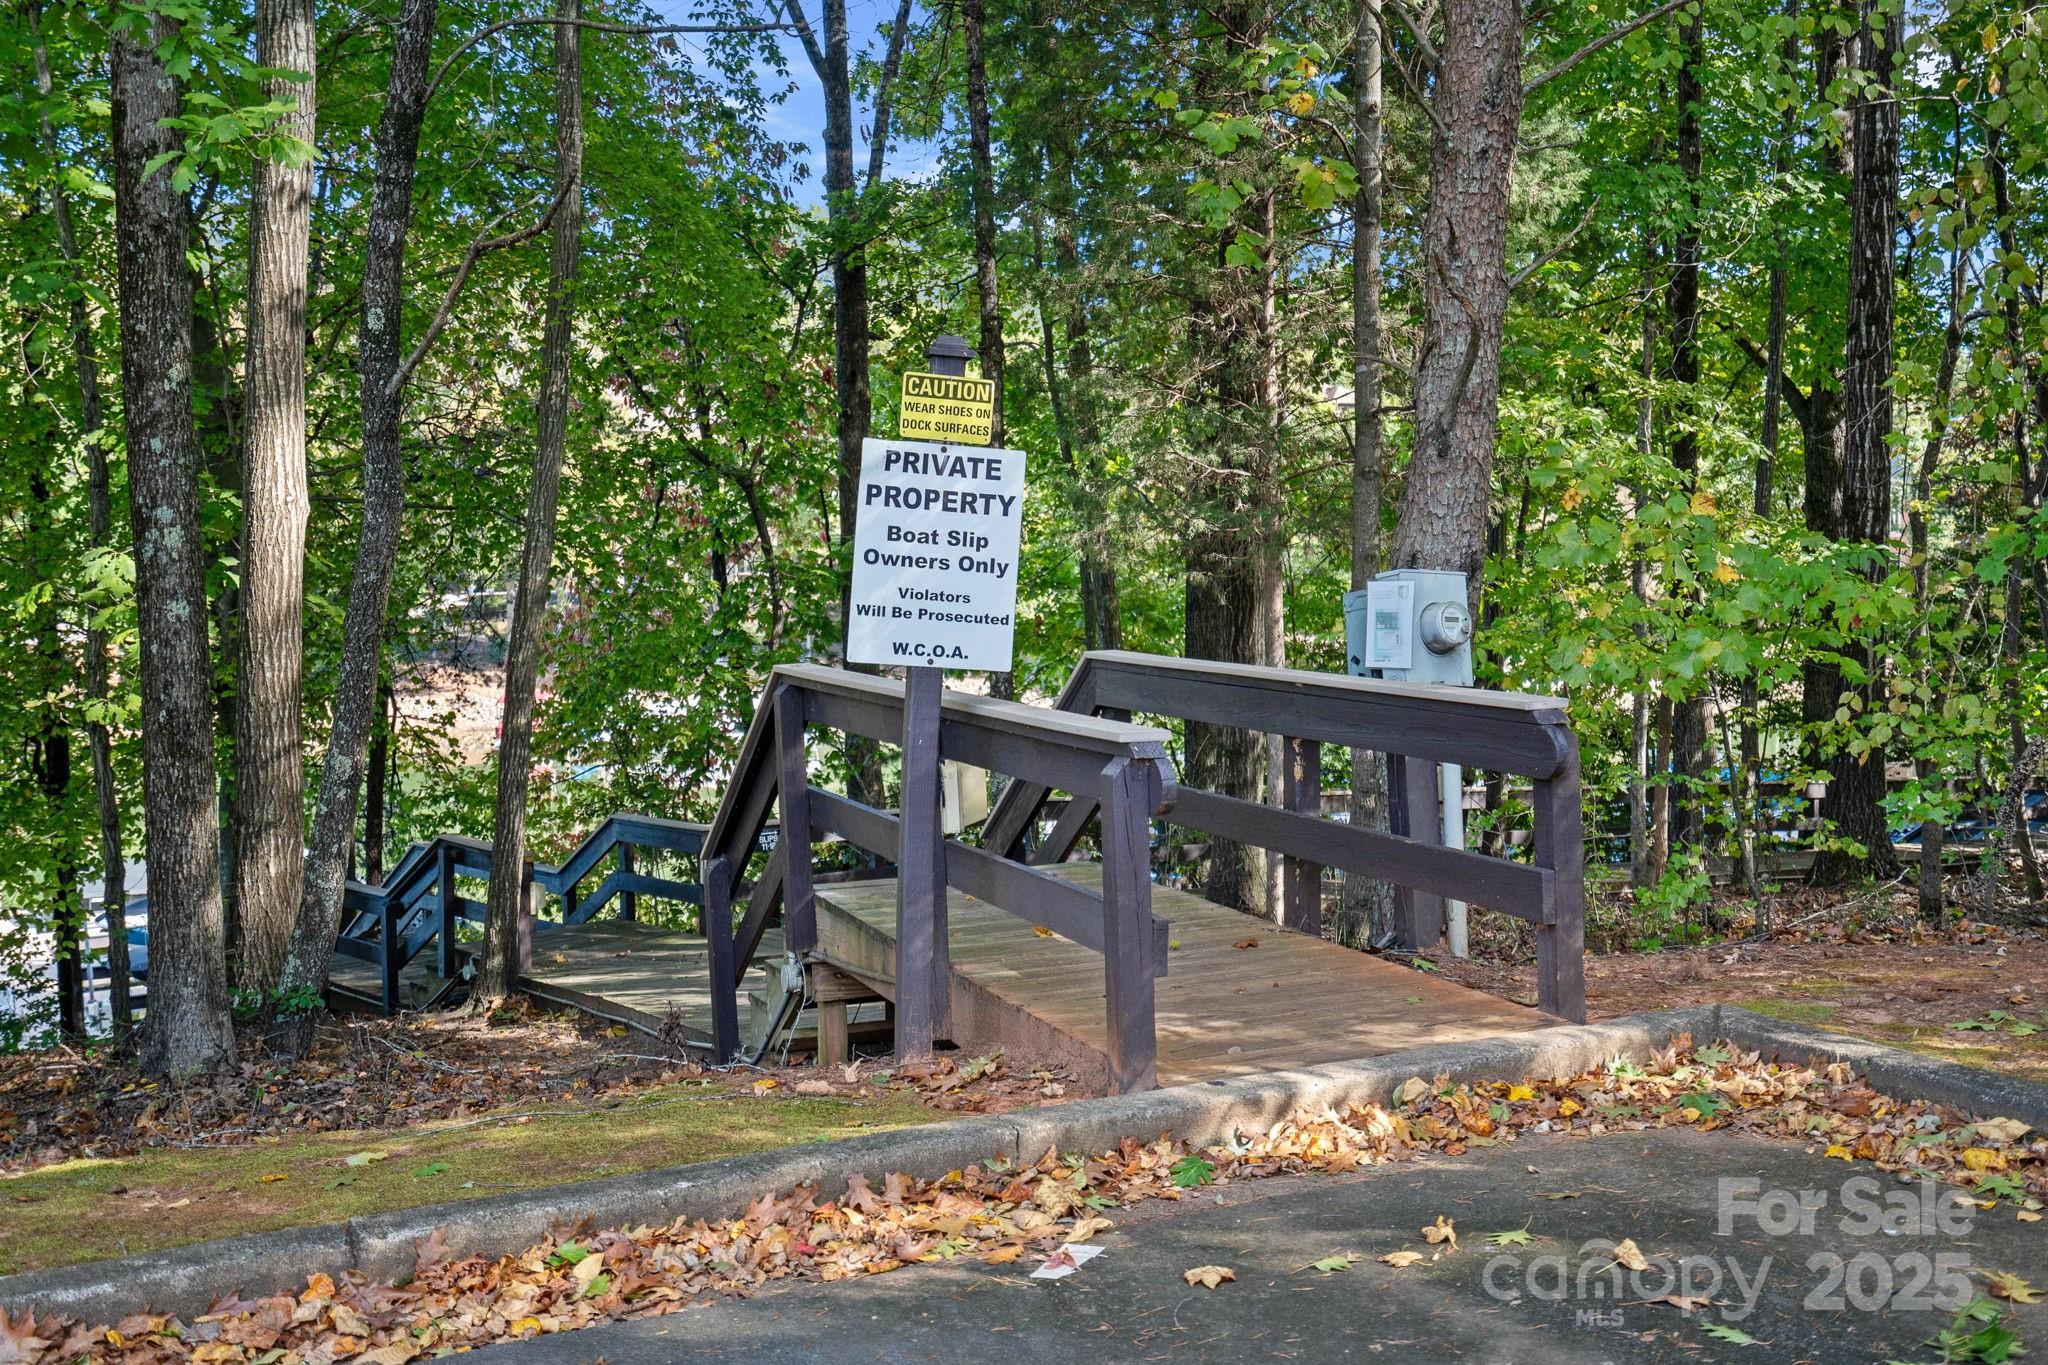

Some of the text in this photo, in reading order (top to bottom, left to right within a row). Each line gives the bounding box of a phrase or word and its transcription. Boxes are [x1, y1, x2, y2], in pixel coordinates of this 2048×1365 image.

[908, 377, 990, 402] CAUTION
[904, 401, 991, 419] WEAR SHOES ON
[902, 418, 989, 437] DOCK SURFACES
[884, 449, 1002, 481] PRIVATE
[865, 483, 1016, 517] PROPERTY
[887, 525, 989, 552] Boat Slip
[863, 548, 1009, 579] Owners Only
[898, 587, 971, 604] Violators
[856, 603, 1010, 626] Will Be Prosecuted
[892, 642, 969, 660] W.C.O.A.
[759, 834, 778, 844] SLIPS
